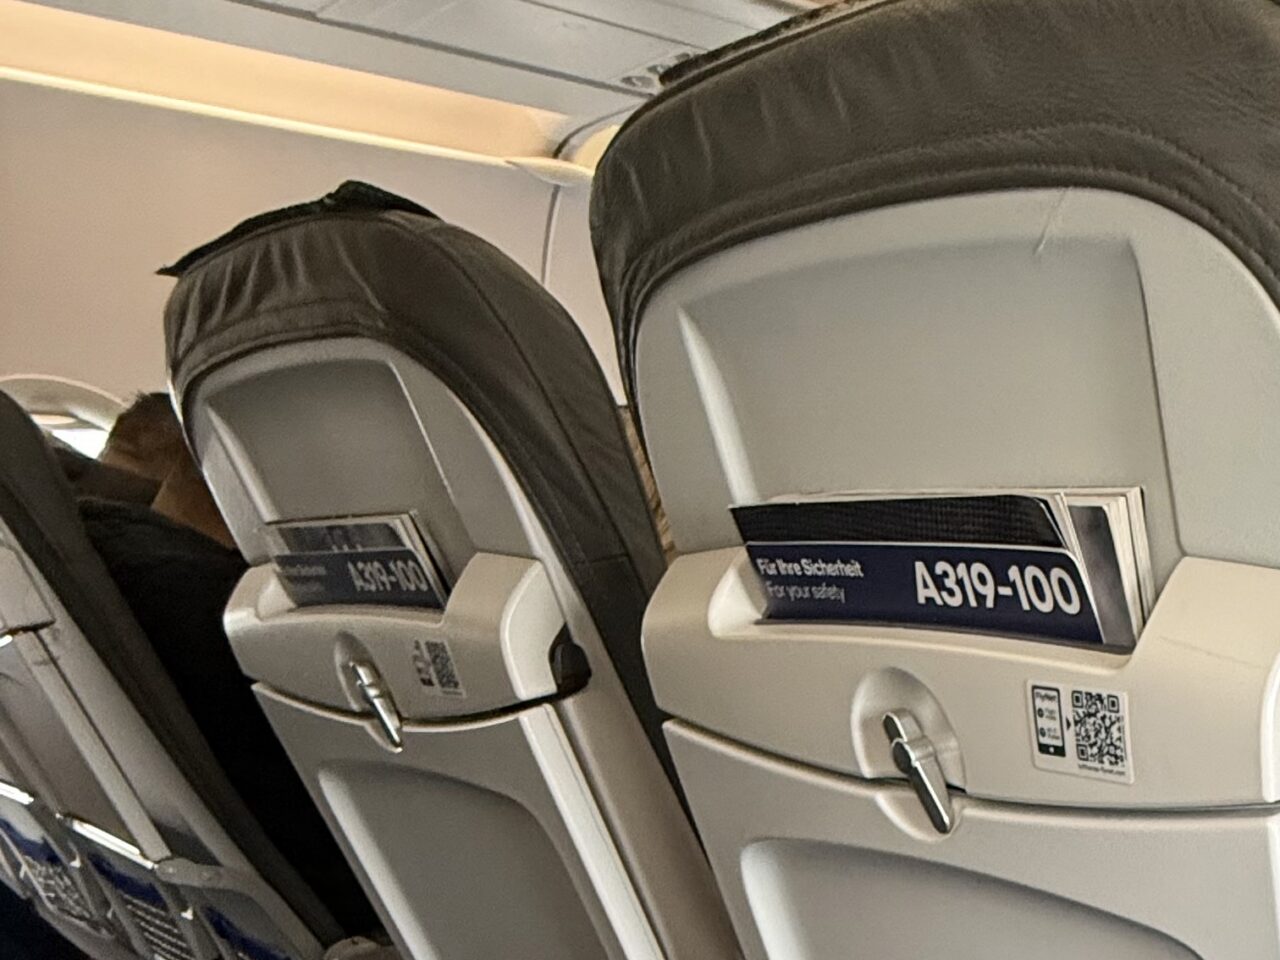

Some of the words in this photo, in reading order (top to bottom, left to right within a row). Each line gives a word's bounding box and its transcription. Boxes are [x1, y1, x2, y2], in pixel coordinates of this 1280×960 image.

[347, 559, 429, 592] A319-100
[801, 558, 865, 578] Sicherheit
[914, 560, 1081, 616] A319-100
